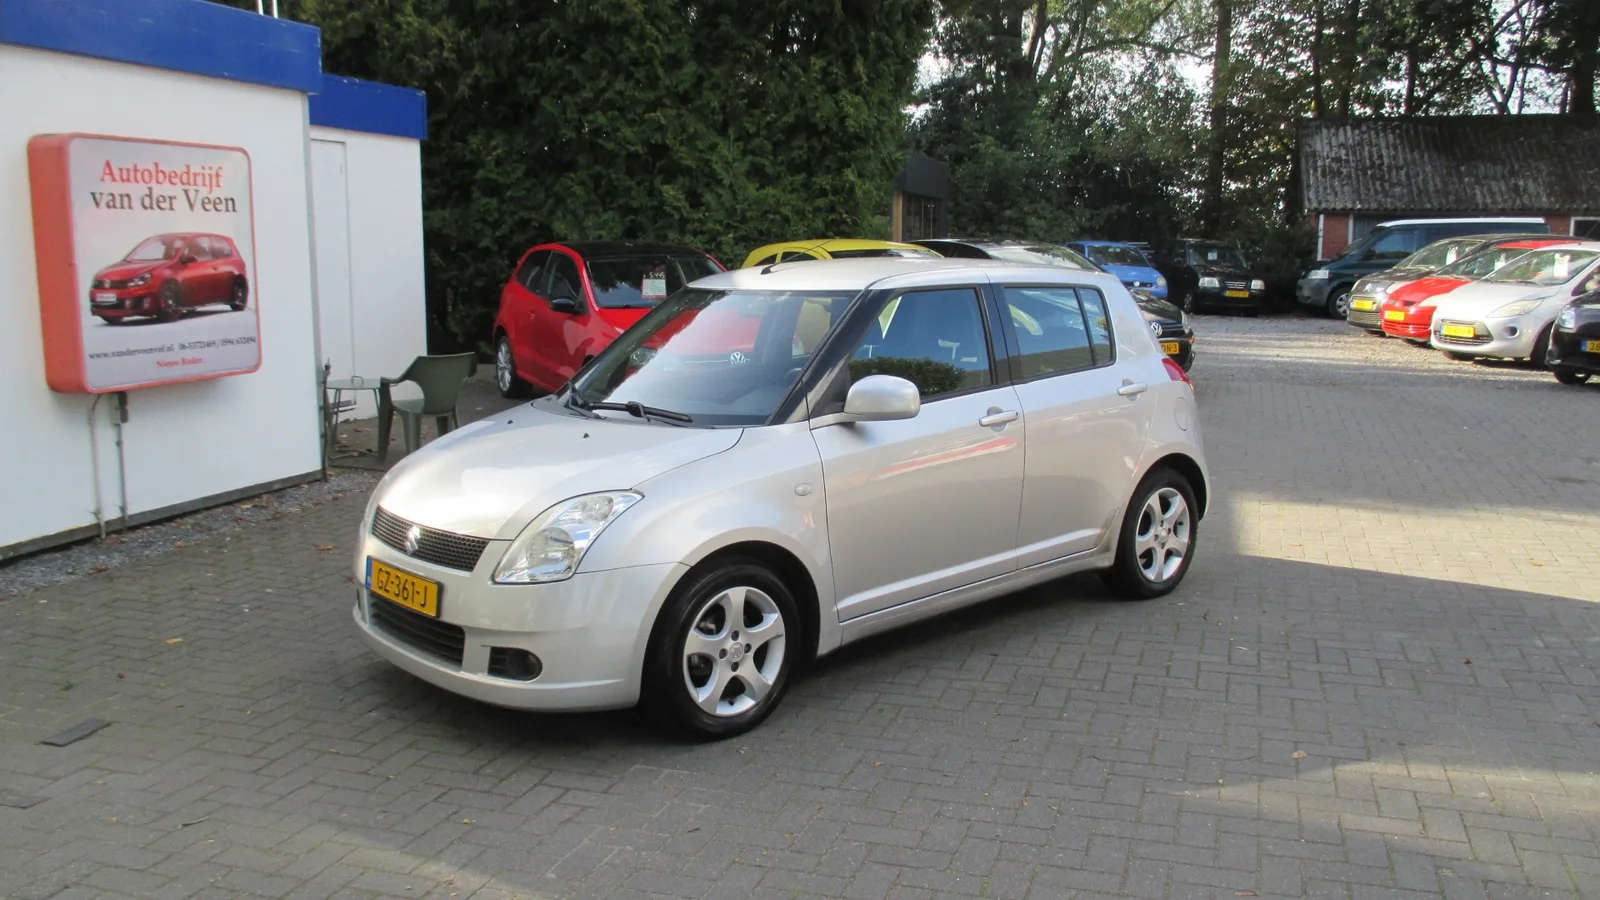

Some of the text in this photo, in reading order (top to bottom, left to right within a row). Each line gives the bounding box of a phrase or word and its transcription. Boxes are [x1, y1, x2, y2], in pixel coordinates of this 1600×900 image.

[100, 159, 223, 194] Autobedrijf
[90, 187, 237, 213] van der Veen
[377, 567, 428, 608] GZ-361-J
